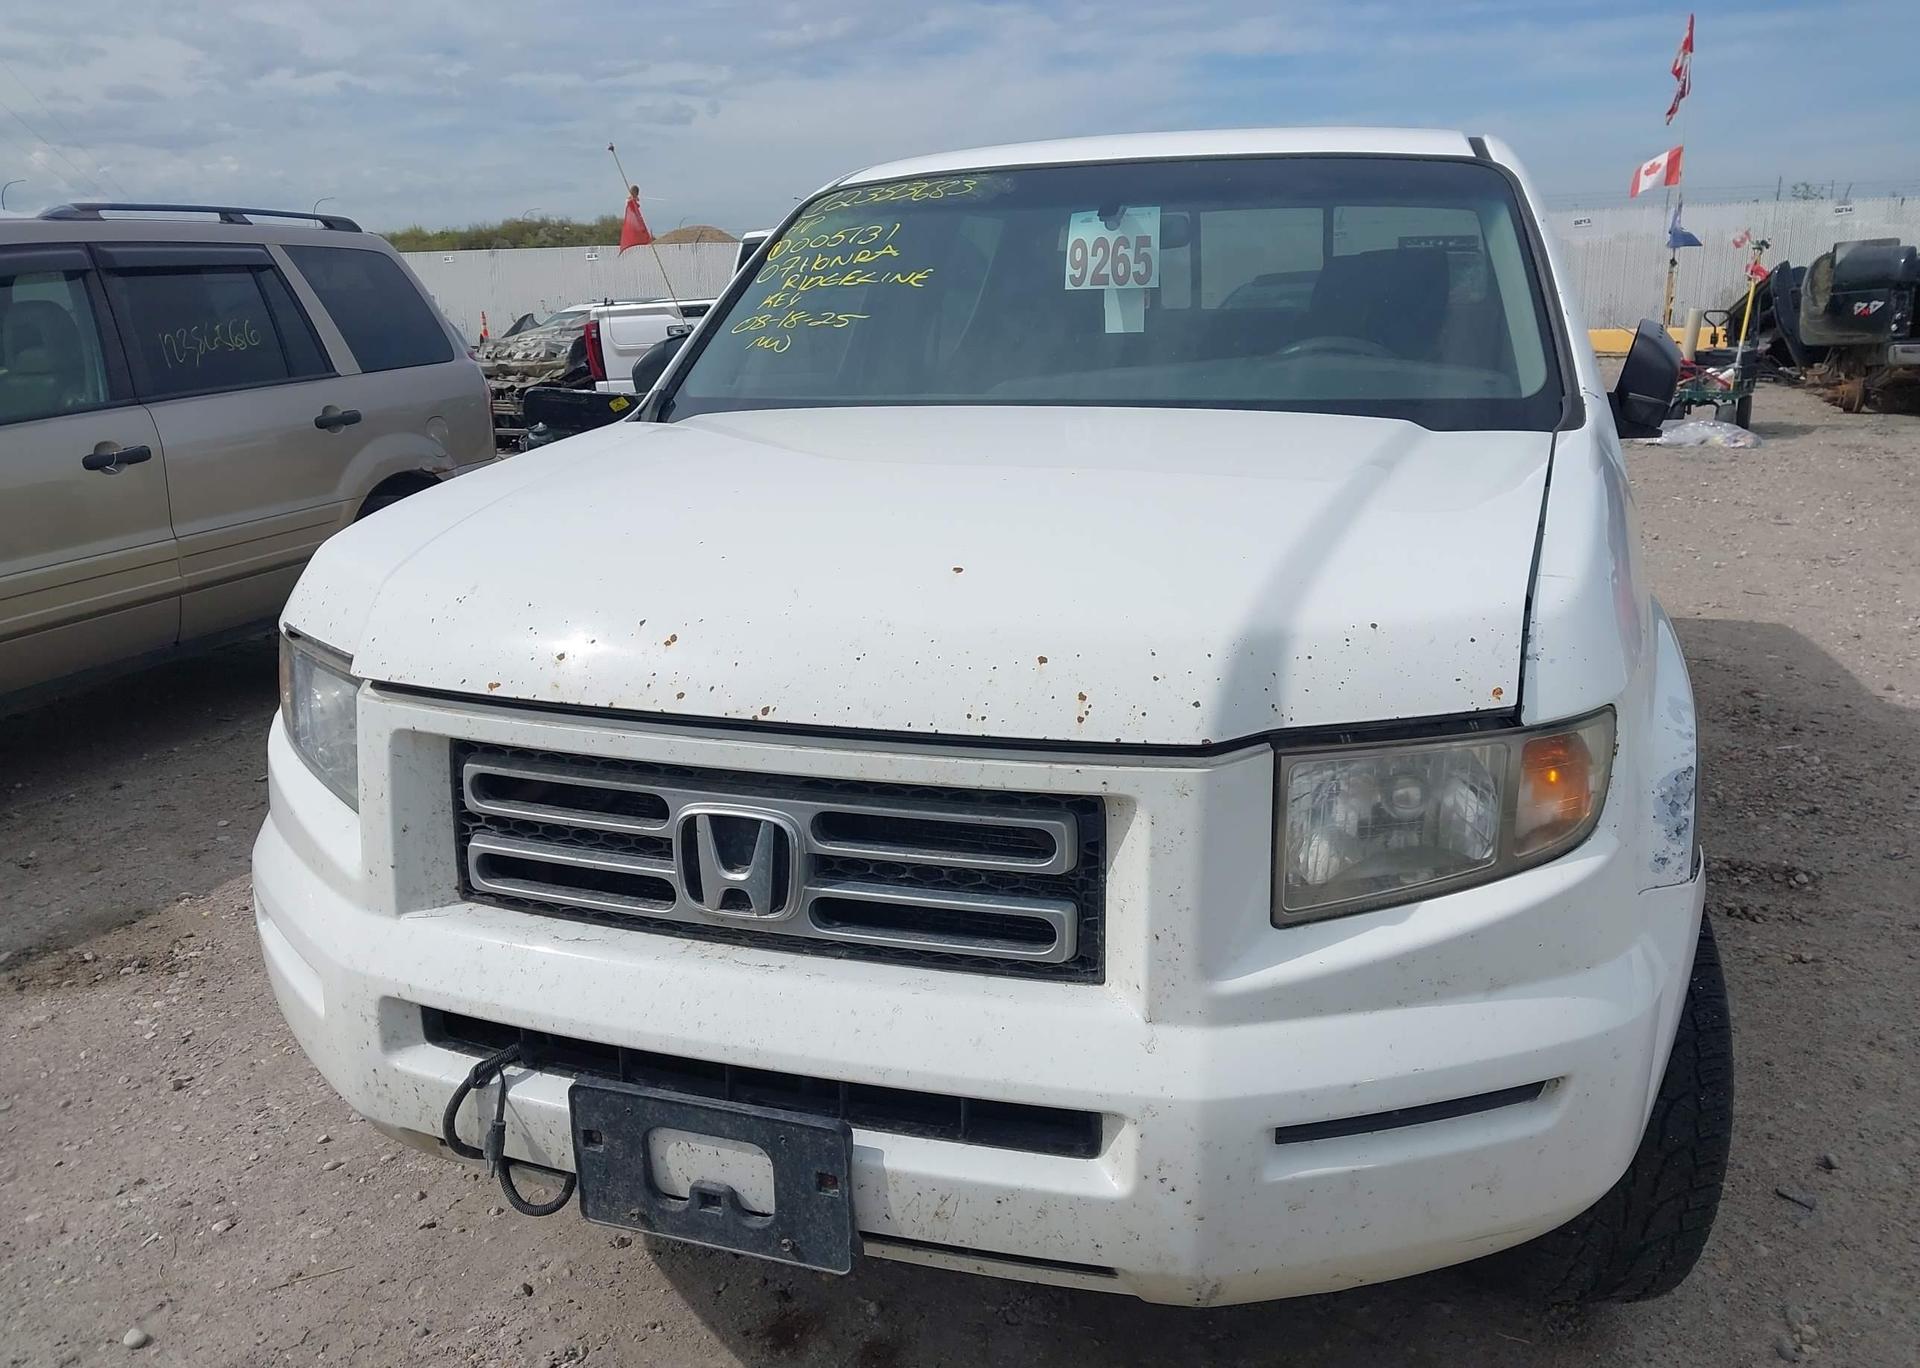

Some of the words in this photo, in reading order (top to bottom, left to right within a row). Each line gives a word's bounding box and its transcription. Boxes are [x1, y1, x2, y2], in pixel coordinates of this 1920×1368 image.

[1068, 234, 1153, 288] 9265
[781, 268, 935, 292] RIDGELINE
[756, 292, 803, 310] KEY
